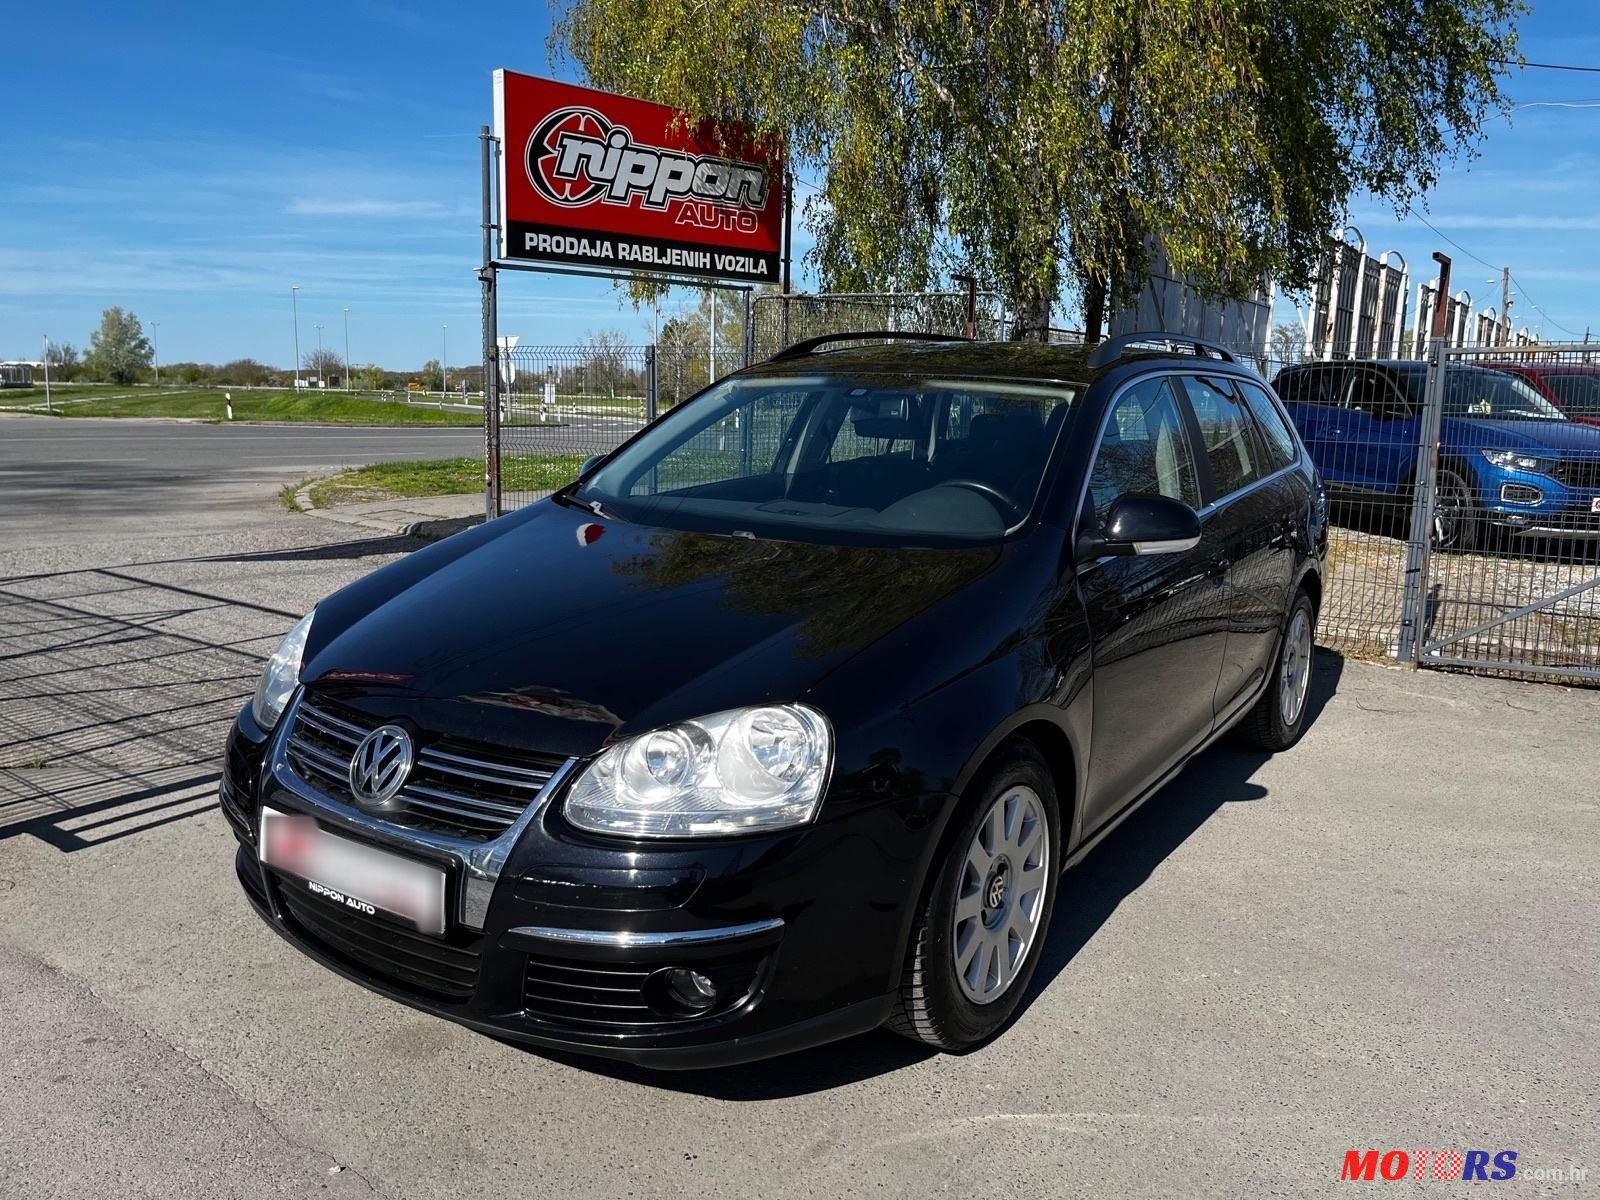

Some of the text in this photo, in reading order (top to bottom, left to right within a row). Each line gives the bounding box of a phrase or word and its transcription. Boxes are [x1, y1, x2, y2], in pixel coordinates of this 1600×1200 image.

[556, 127, 768, 210] nippon
[675, 202, 758, 233] AUTO
[525, 232, 768, 275] PRODAJA RABLJENIH VOZILA
[346, 898, 375, 915] AUTO
